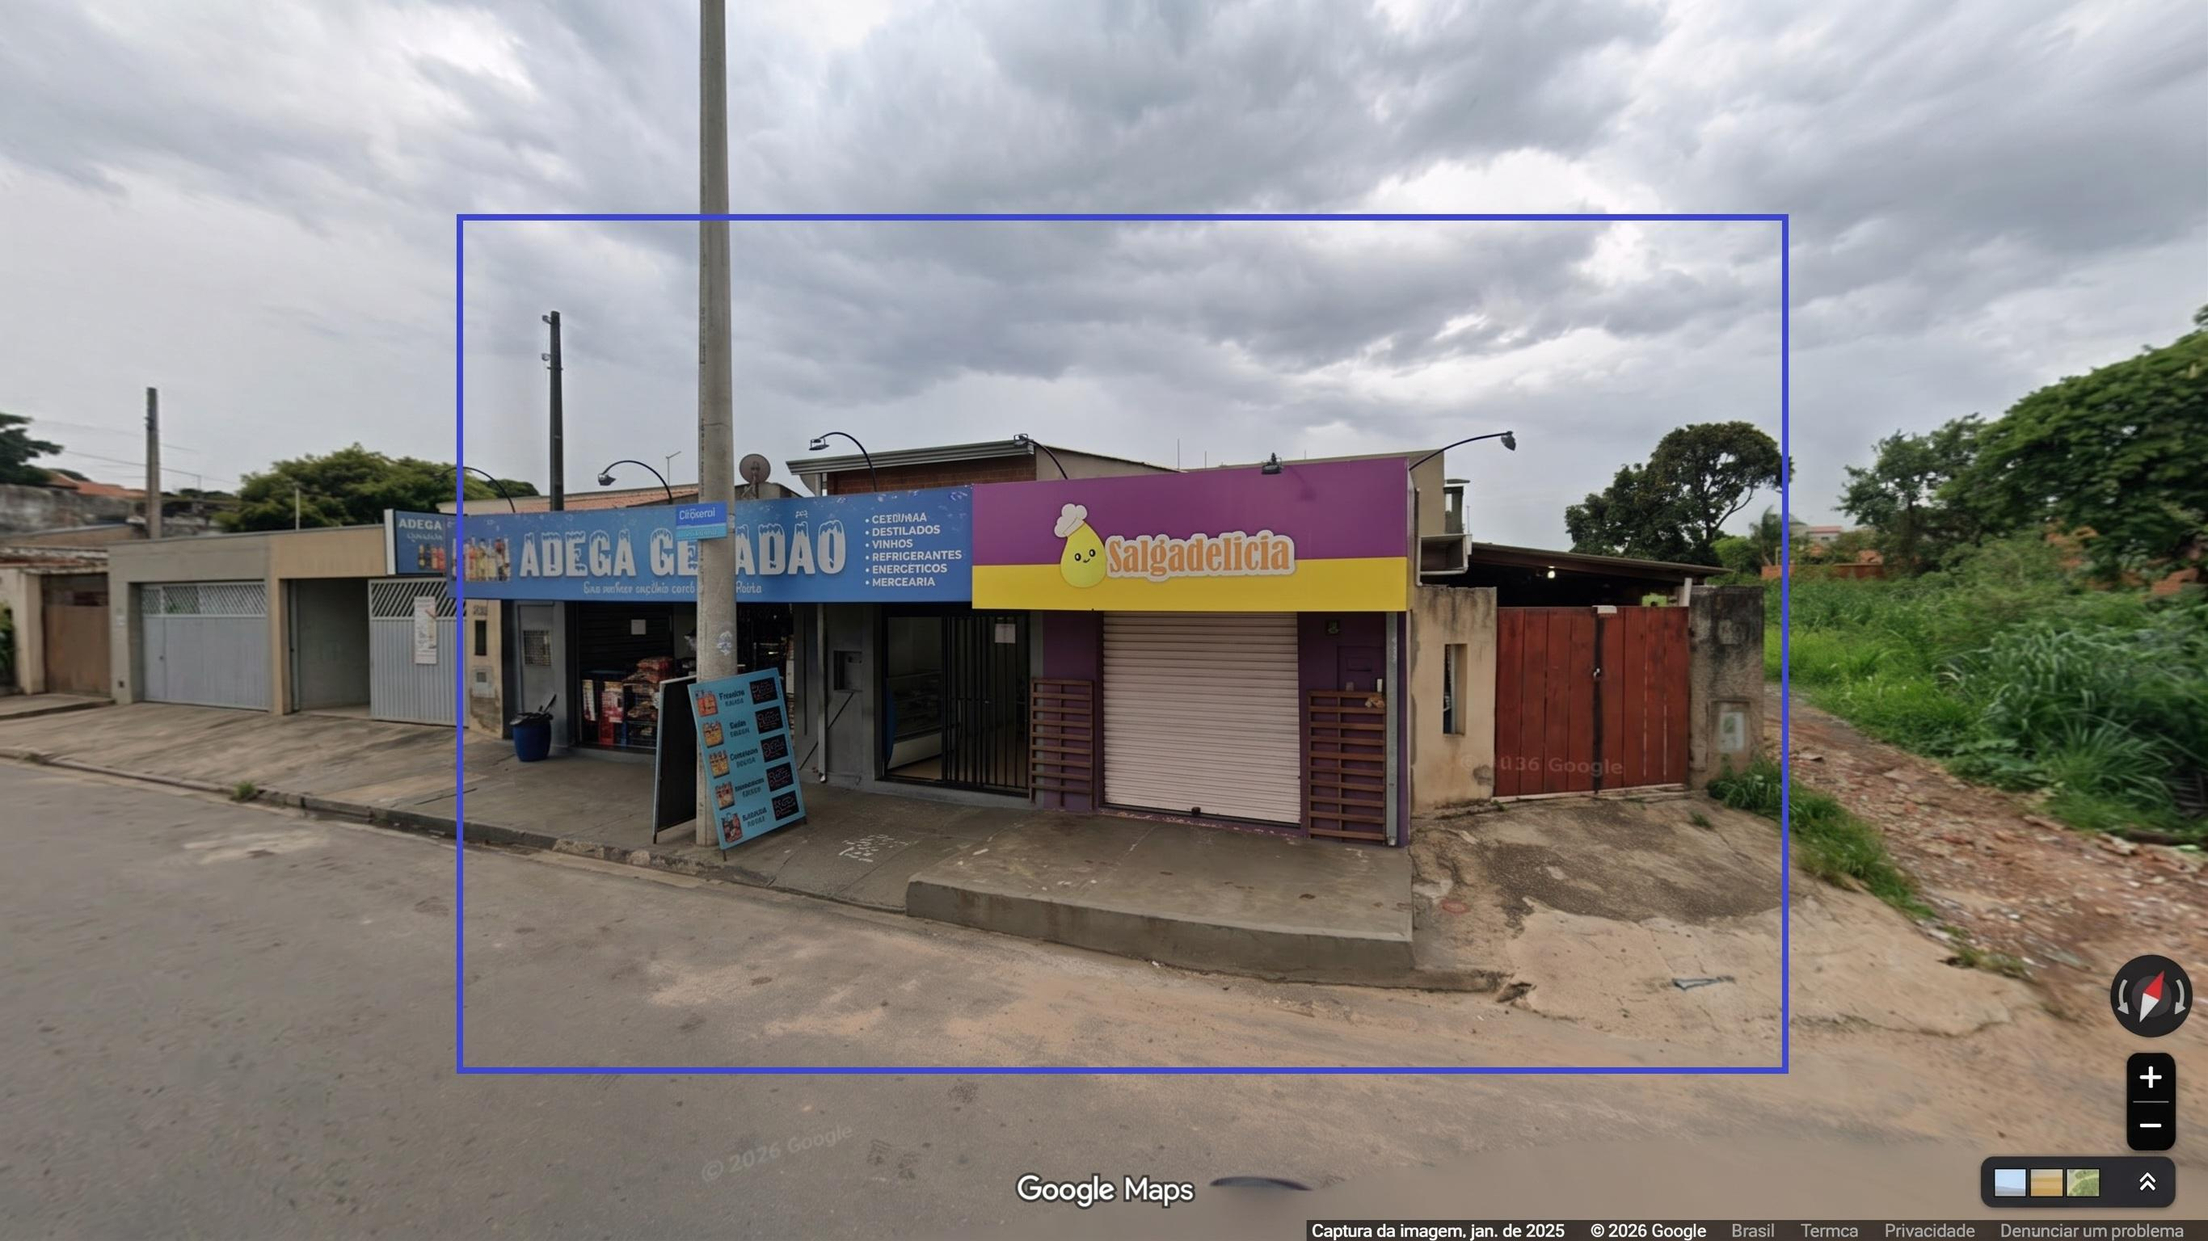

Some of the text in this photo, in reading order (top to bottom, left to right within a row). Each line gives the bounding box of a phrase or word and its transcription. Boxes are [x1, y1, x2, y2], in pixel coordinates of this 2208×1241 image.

[399, 518, 442, 531] ADEGA
[872, 525, 941, 537] DESTILADOS
[519, 510, 847, 577] ADEGA GEADÃO
[872, 539, 913, 549] VINHOS
[872, 550, 963, 562] REFRIGERANTES
[1109, 535, 1290, 577] Salgadelicia
[872, 577, 936, 587] MERCEARIA
